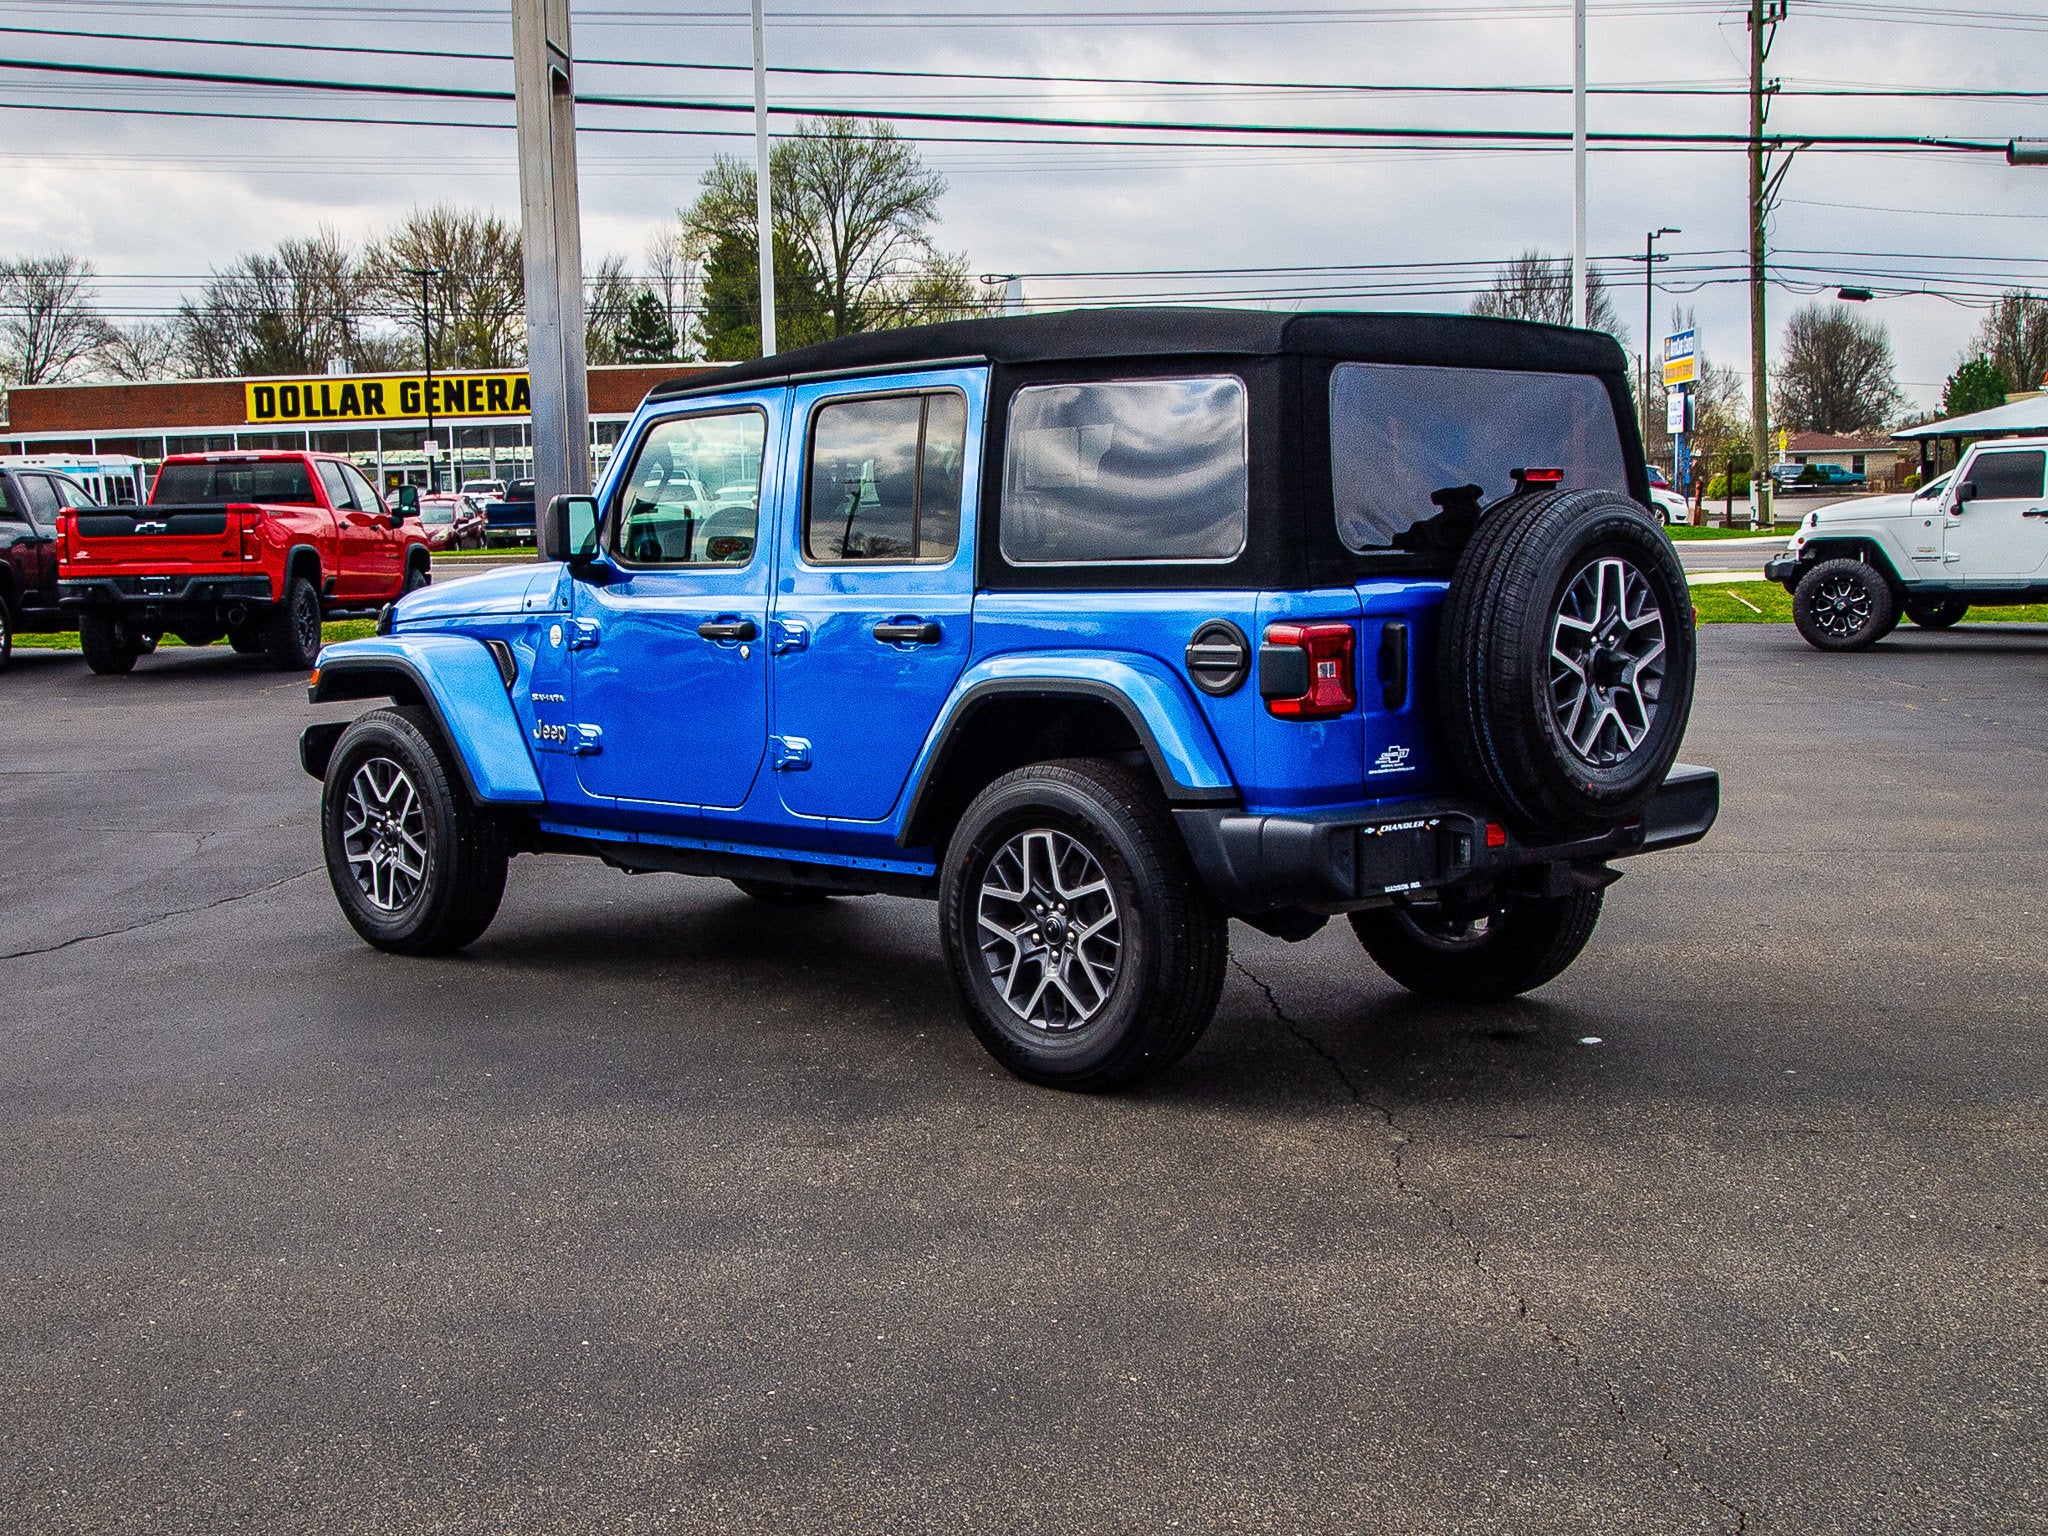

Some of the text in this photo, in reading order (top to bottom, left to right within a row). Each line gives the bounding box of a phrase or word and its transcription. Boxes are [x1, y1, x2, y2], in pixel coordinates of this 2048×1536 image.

[253, 378, 531, 418] DOLLAR GENERA
[533, 719, 566, 744] Jeep
[1380, 820, 1425, 832] CHANDLER
